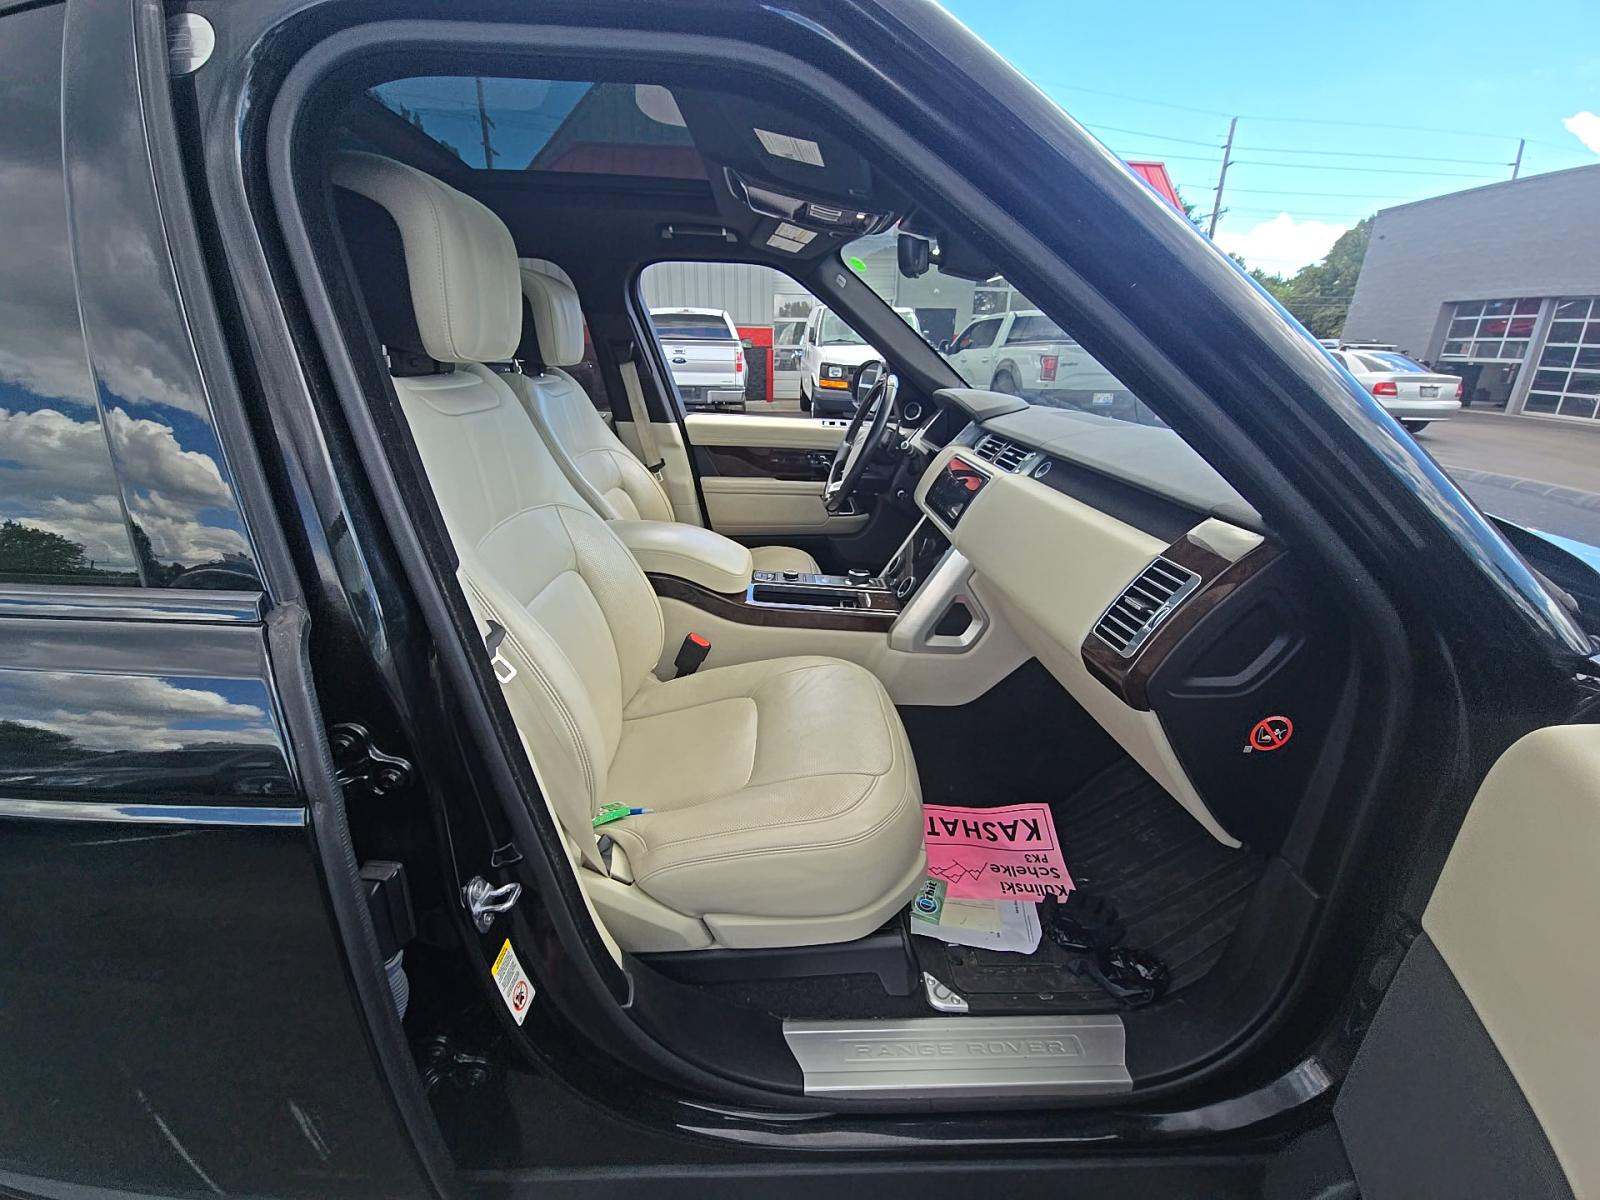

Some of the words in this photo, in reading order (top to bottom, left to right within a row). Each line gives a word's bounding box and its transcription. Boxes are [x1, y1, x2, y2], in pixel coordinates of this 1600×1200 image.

[927, 816, 1042, 842] KASHAT
[1025, 853, 1049, 864] PK3
[990, 863, 1061, 879] Schelke
[915, 880, 939, 914] Orbit
[1000, 880, 1068, 897] Kulinski
[854, 1042, 954, 1057] RANGE
[967, 1040, 1066, 1056] ROVER
